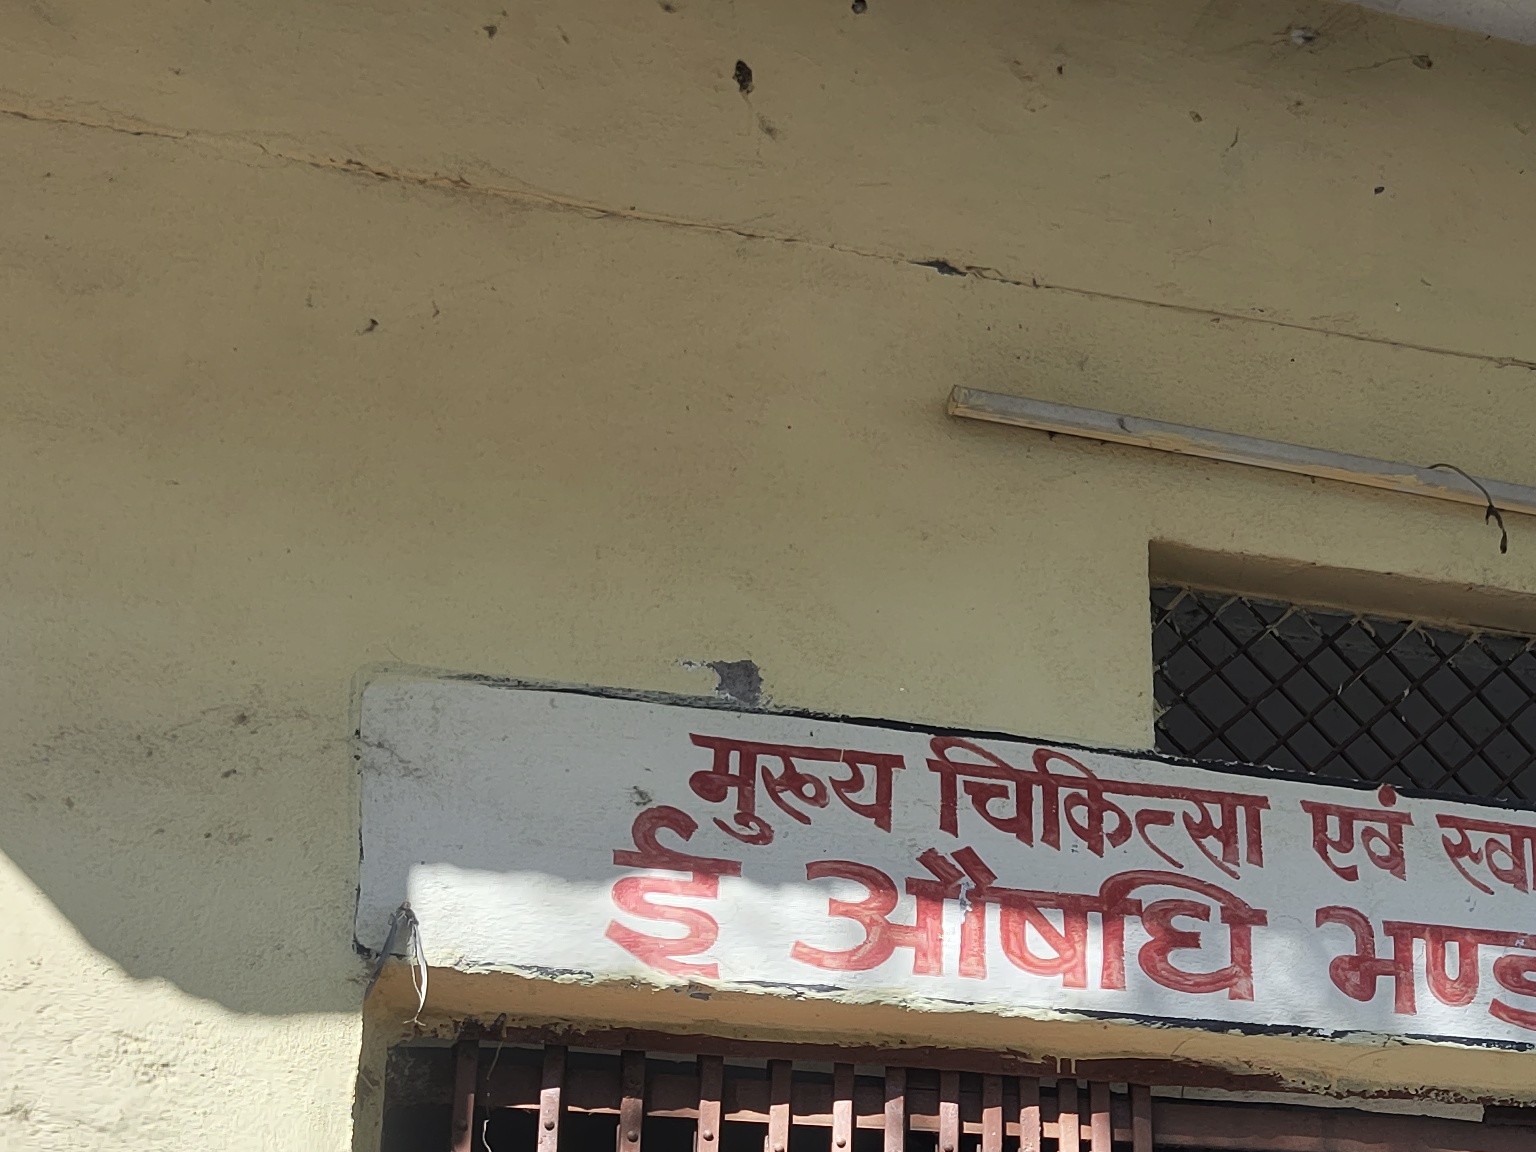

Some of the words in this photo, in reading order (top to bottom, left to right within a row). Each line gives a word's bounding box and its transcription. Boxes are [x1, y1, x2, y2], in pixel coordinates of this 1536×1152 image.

[926, 736, 1271, 880] चिकित्सा
[1300, 784, 1414, 882] एवं
[605, 805, 742, 979] ई
[790, 846, 1269, 1000] औषधि
